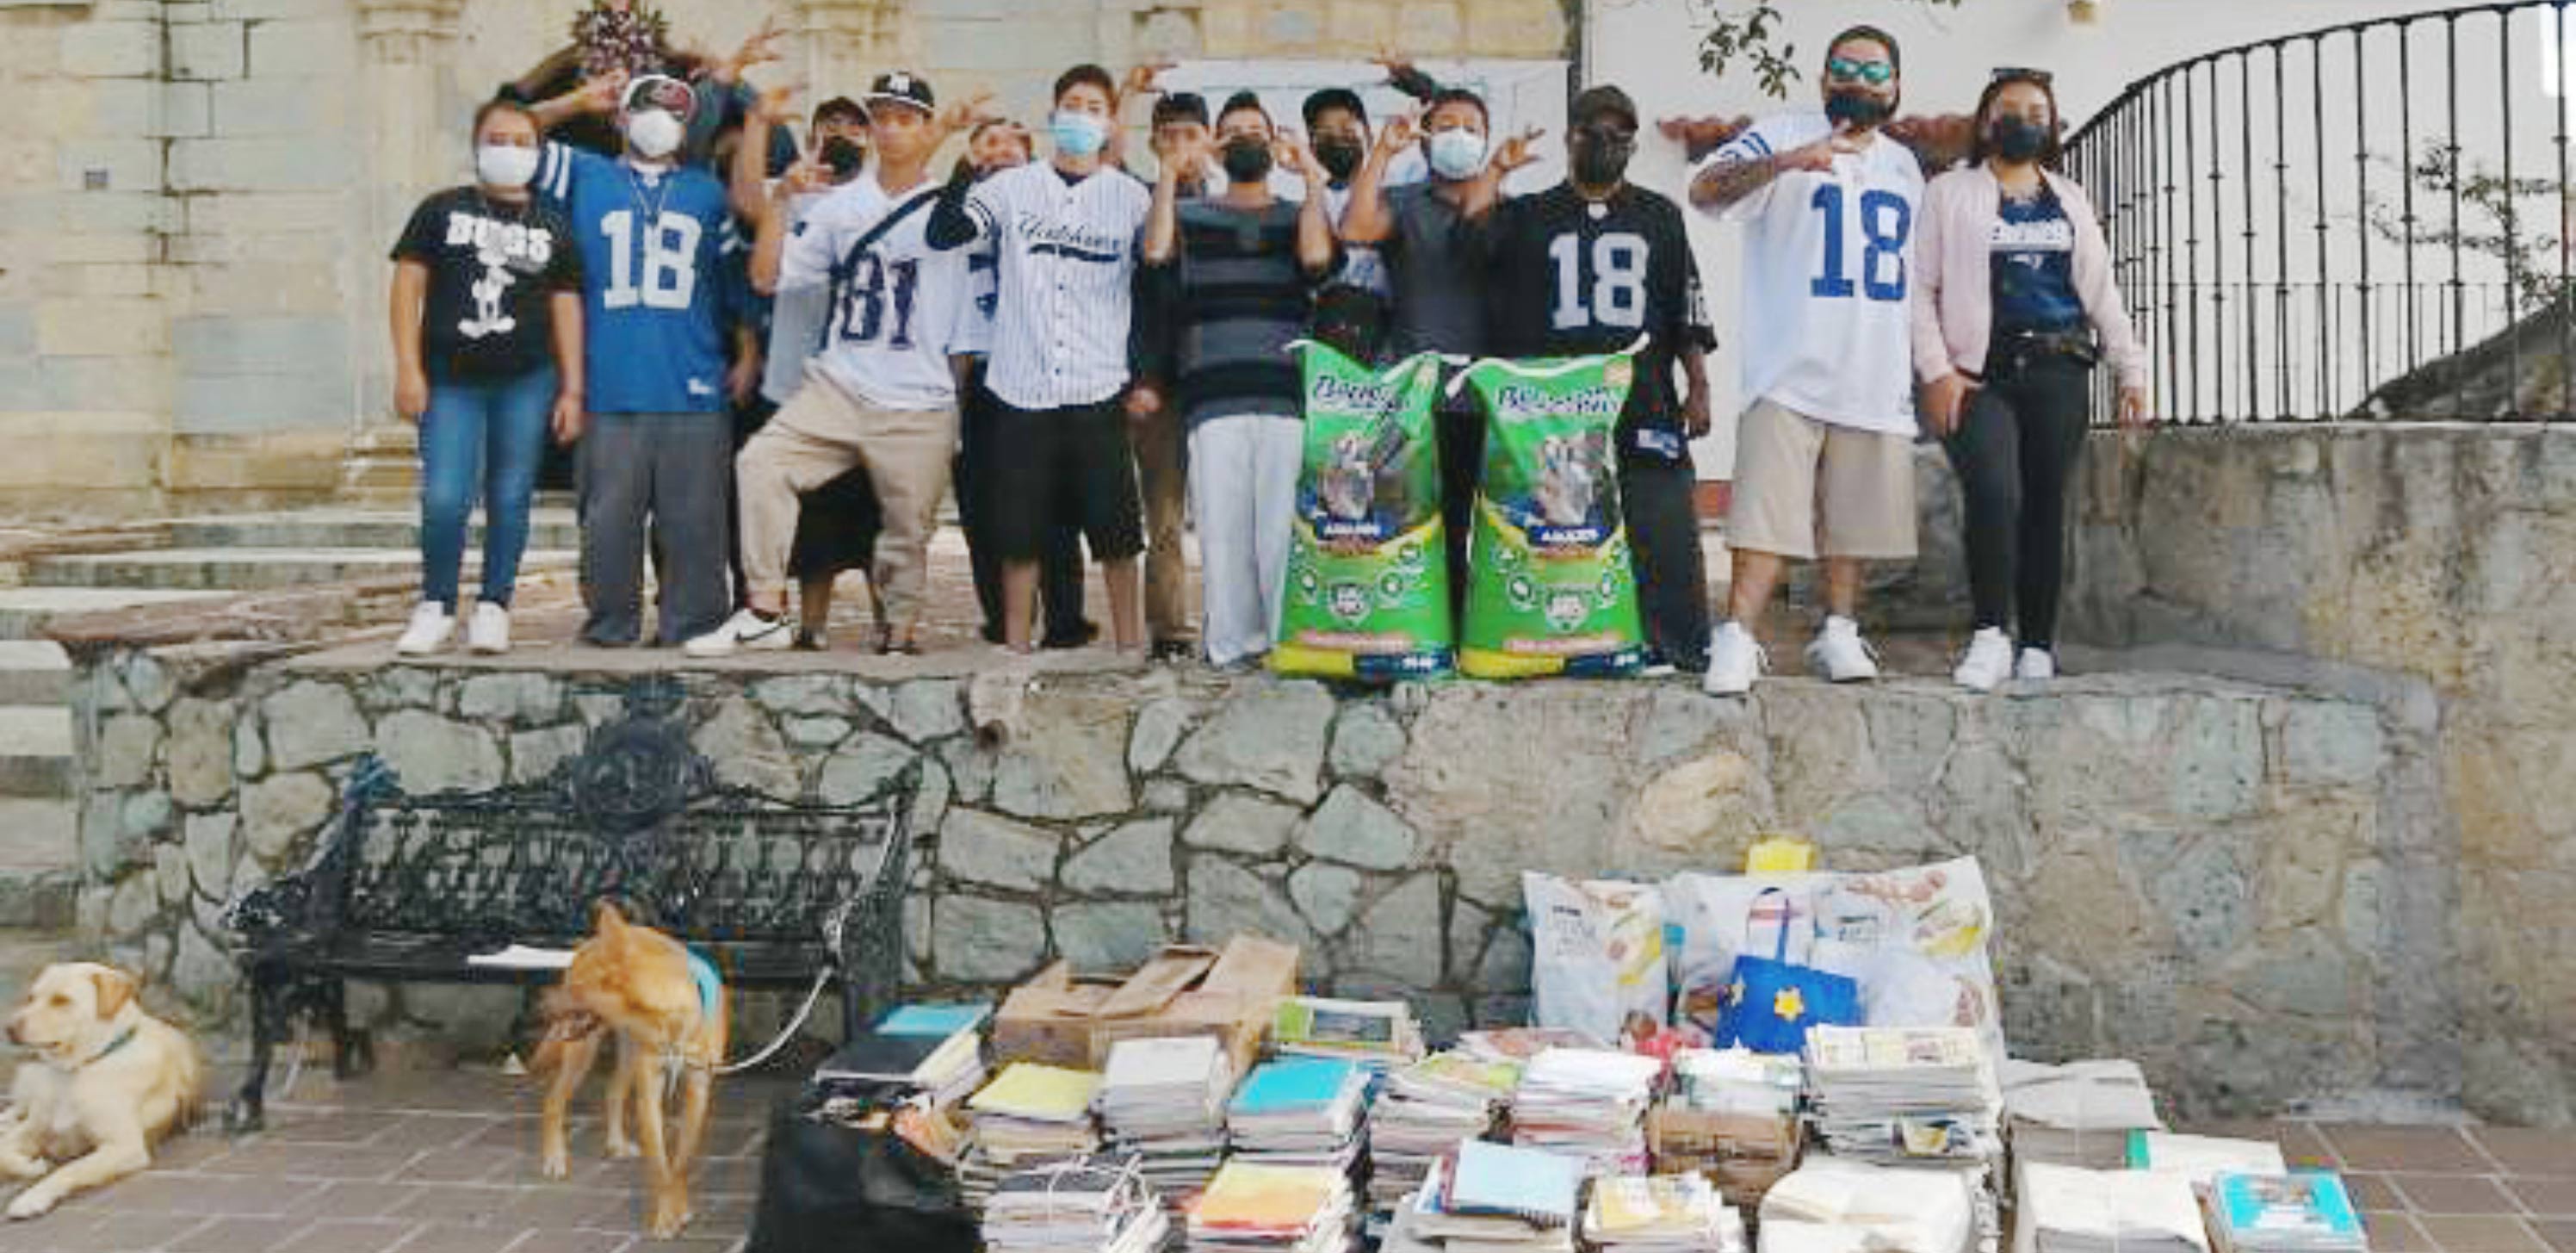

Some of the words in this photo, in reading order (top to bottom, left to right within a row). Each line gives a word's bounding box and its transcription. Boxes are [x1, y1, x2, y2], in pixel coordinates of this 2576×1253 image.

[601, 210, 702, 310] 18
[1549, 232, 1650, 329] 18
[1811, 183, 1910, 301] 18
